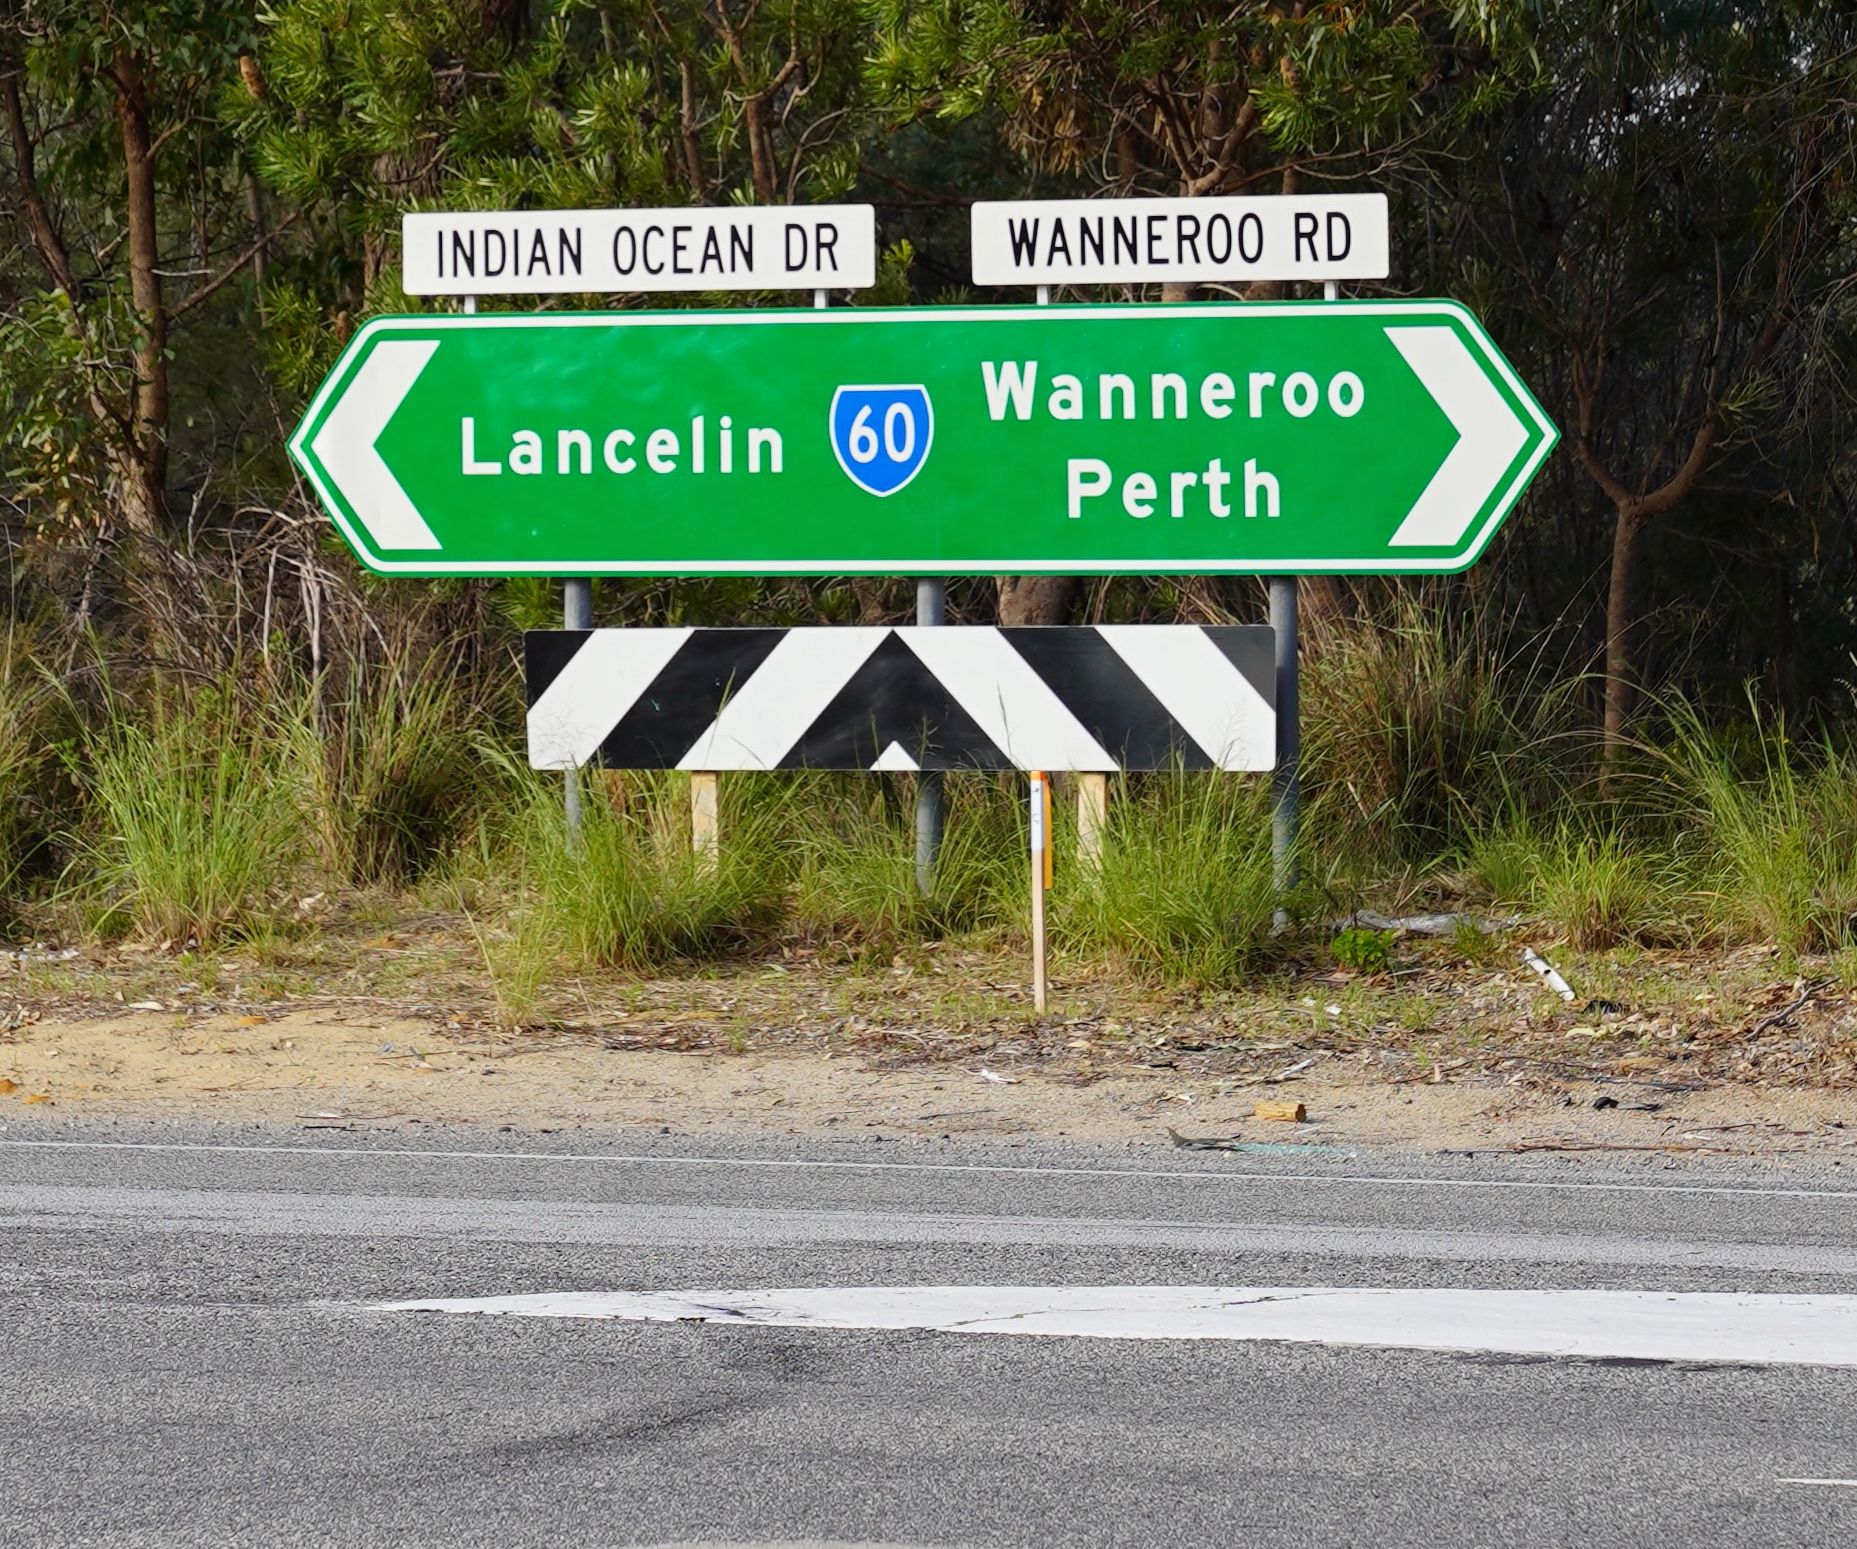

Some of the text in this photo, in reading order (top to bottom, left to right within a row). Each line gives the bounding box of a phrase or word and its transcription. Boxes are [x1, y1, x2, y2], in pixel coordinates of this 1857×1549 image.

[436, 222, 840, 278] INDIAN OCEAN DR
[1007, 211, 1353, 267] WANNEROO RD
[981, 360, 1366, 421] Wanneroo
[461, 415, 784, 476] Lancelin
[847, 404, 915, 466] 60
[1066, 458, 1281, 519] Perth
